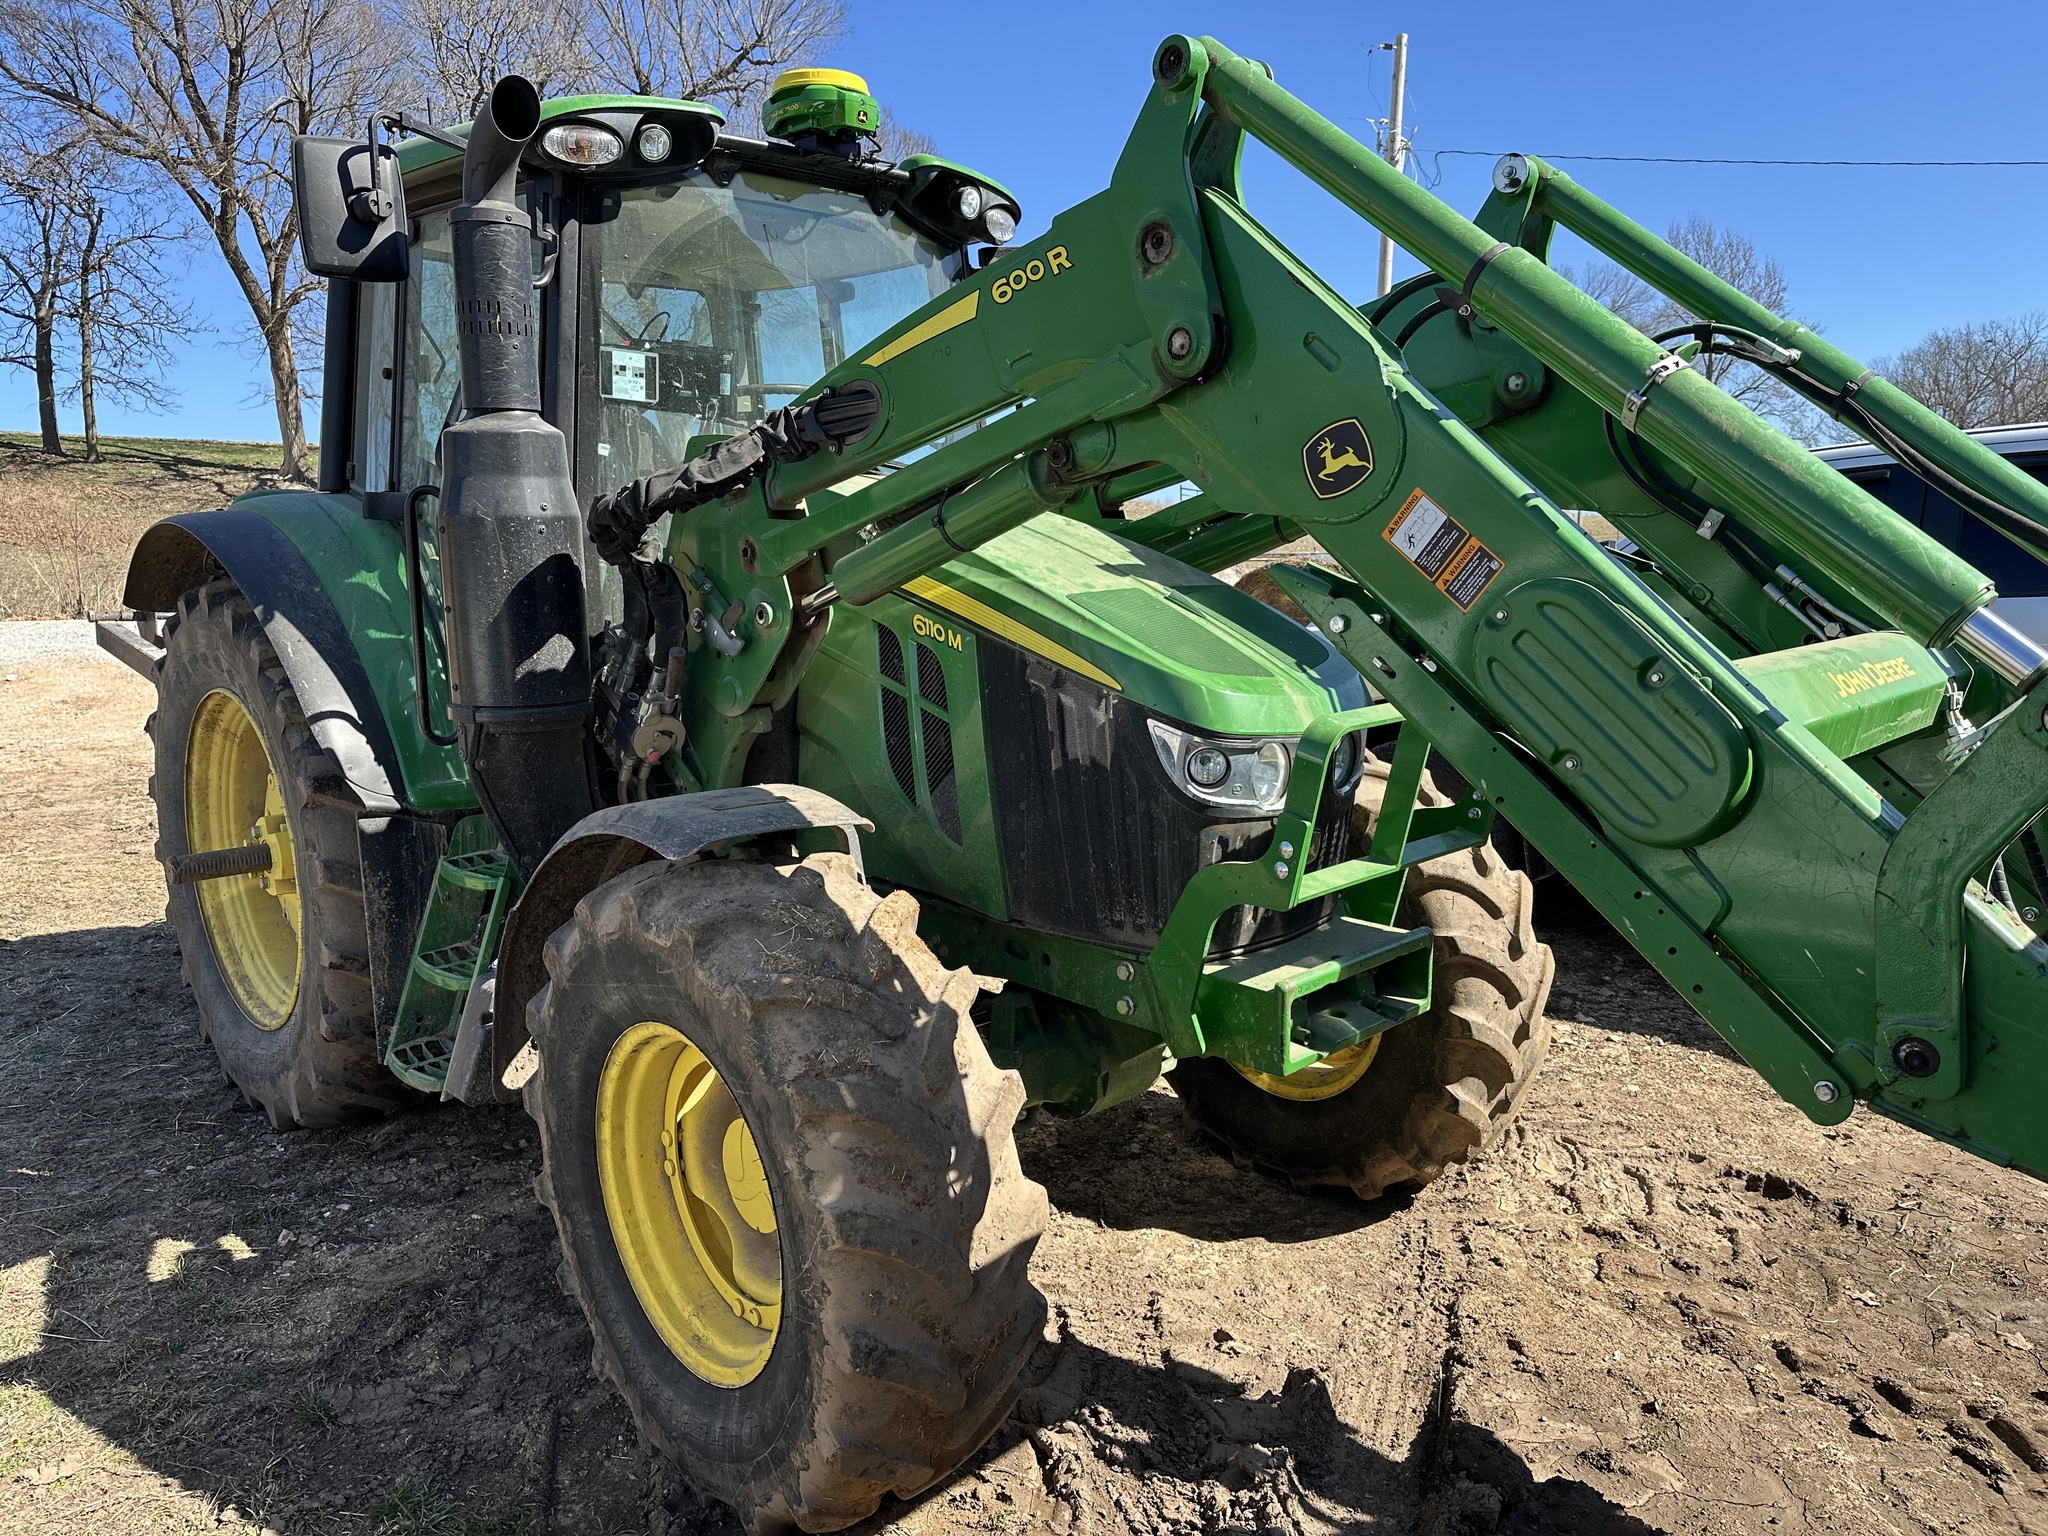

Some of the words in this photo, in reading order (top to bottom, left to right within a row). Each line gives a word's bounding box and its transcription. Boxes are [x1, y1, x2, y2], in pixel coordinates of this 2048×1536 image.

[991, 259, 1045, 304] 600
[1045, 245, 1075, 276] R
[1392, 493, 1419, 527] WARNING
[1447, 544, 1477, 577] WARNING
[912, 613, 946, 642] 6110
[947, 629, 963, 652] M
[1827, 667, 1876, 698] JOHN
[1861, 657, 1917, 686] DEERE
